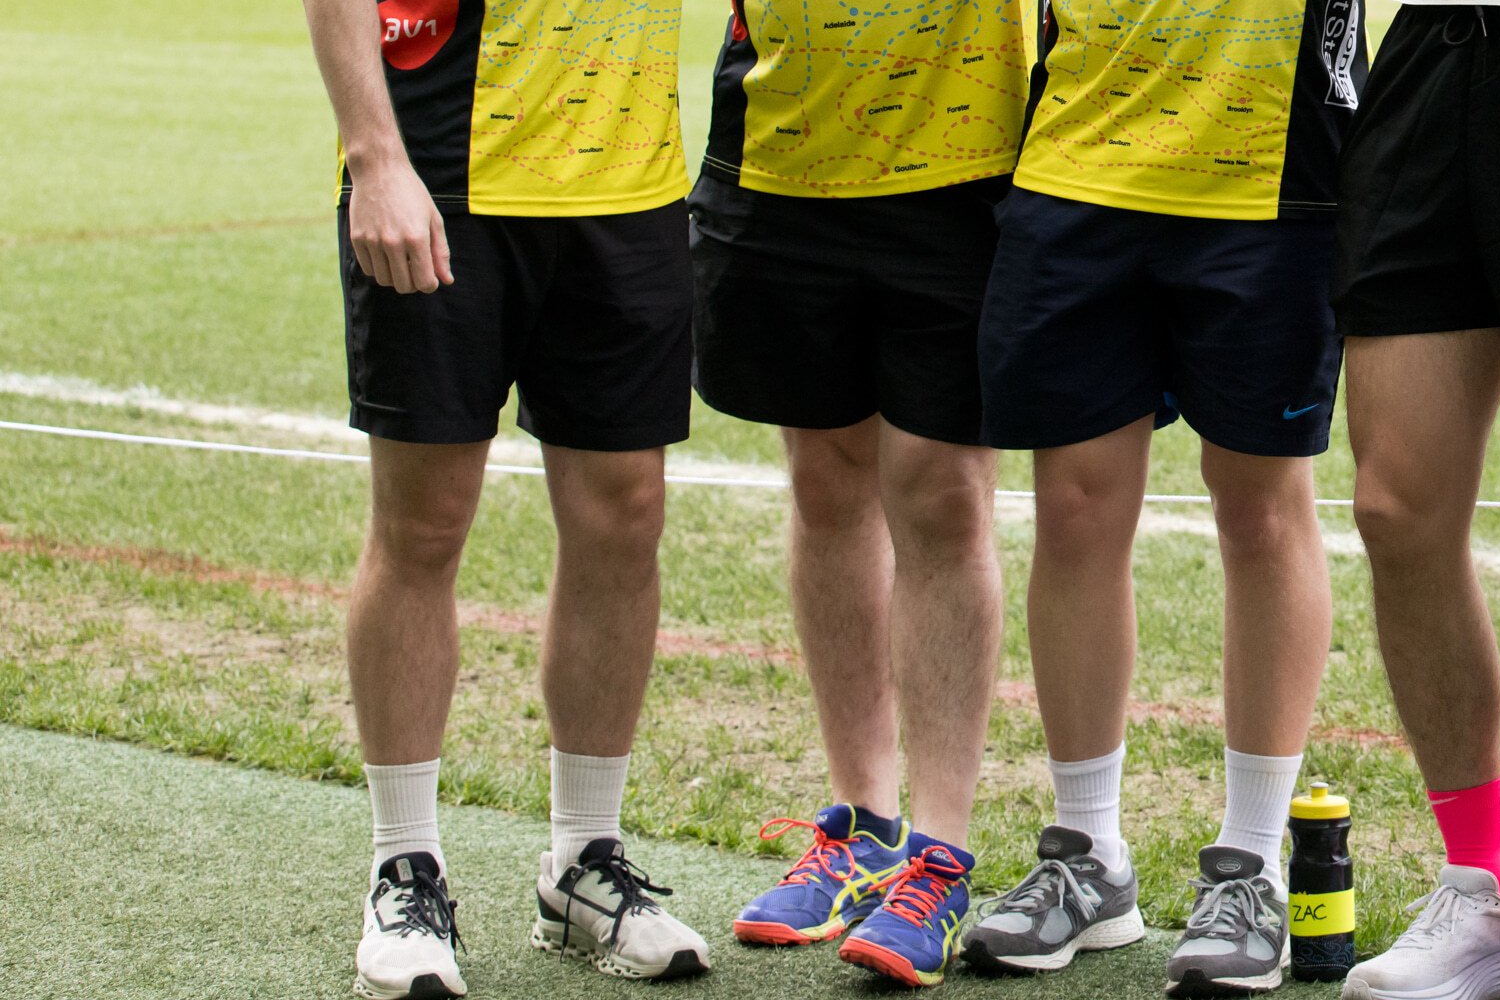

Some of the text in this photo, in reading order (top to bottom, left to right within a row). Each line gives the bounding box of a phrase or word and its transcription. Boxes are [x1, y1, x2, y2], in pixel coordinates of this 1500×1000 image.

[824, 20, 856, 30] Adelaide
[916, 23, 938, 34] Ararat
[962, 54, 984, 65] Bowral
[889, 69, 917, 80] Ballarat
[1128, 66, 1149, 74] Ballarat
[868, 104, 903, 115] Canberra
[947, 103, 970, 114] Forster
[490, 113, 515, 121] Bendigo
[776, 127, 801, 136] Bendigo
[894, 161, 928, 173] Goulburn
[1214, 158, 1235, 166] Hawks
[1292, 903, 1327, 922] ZAC
